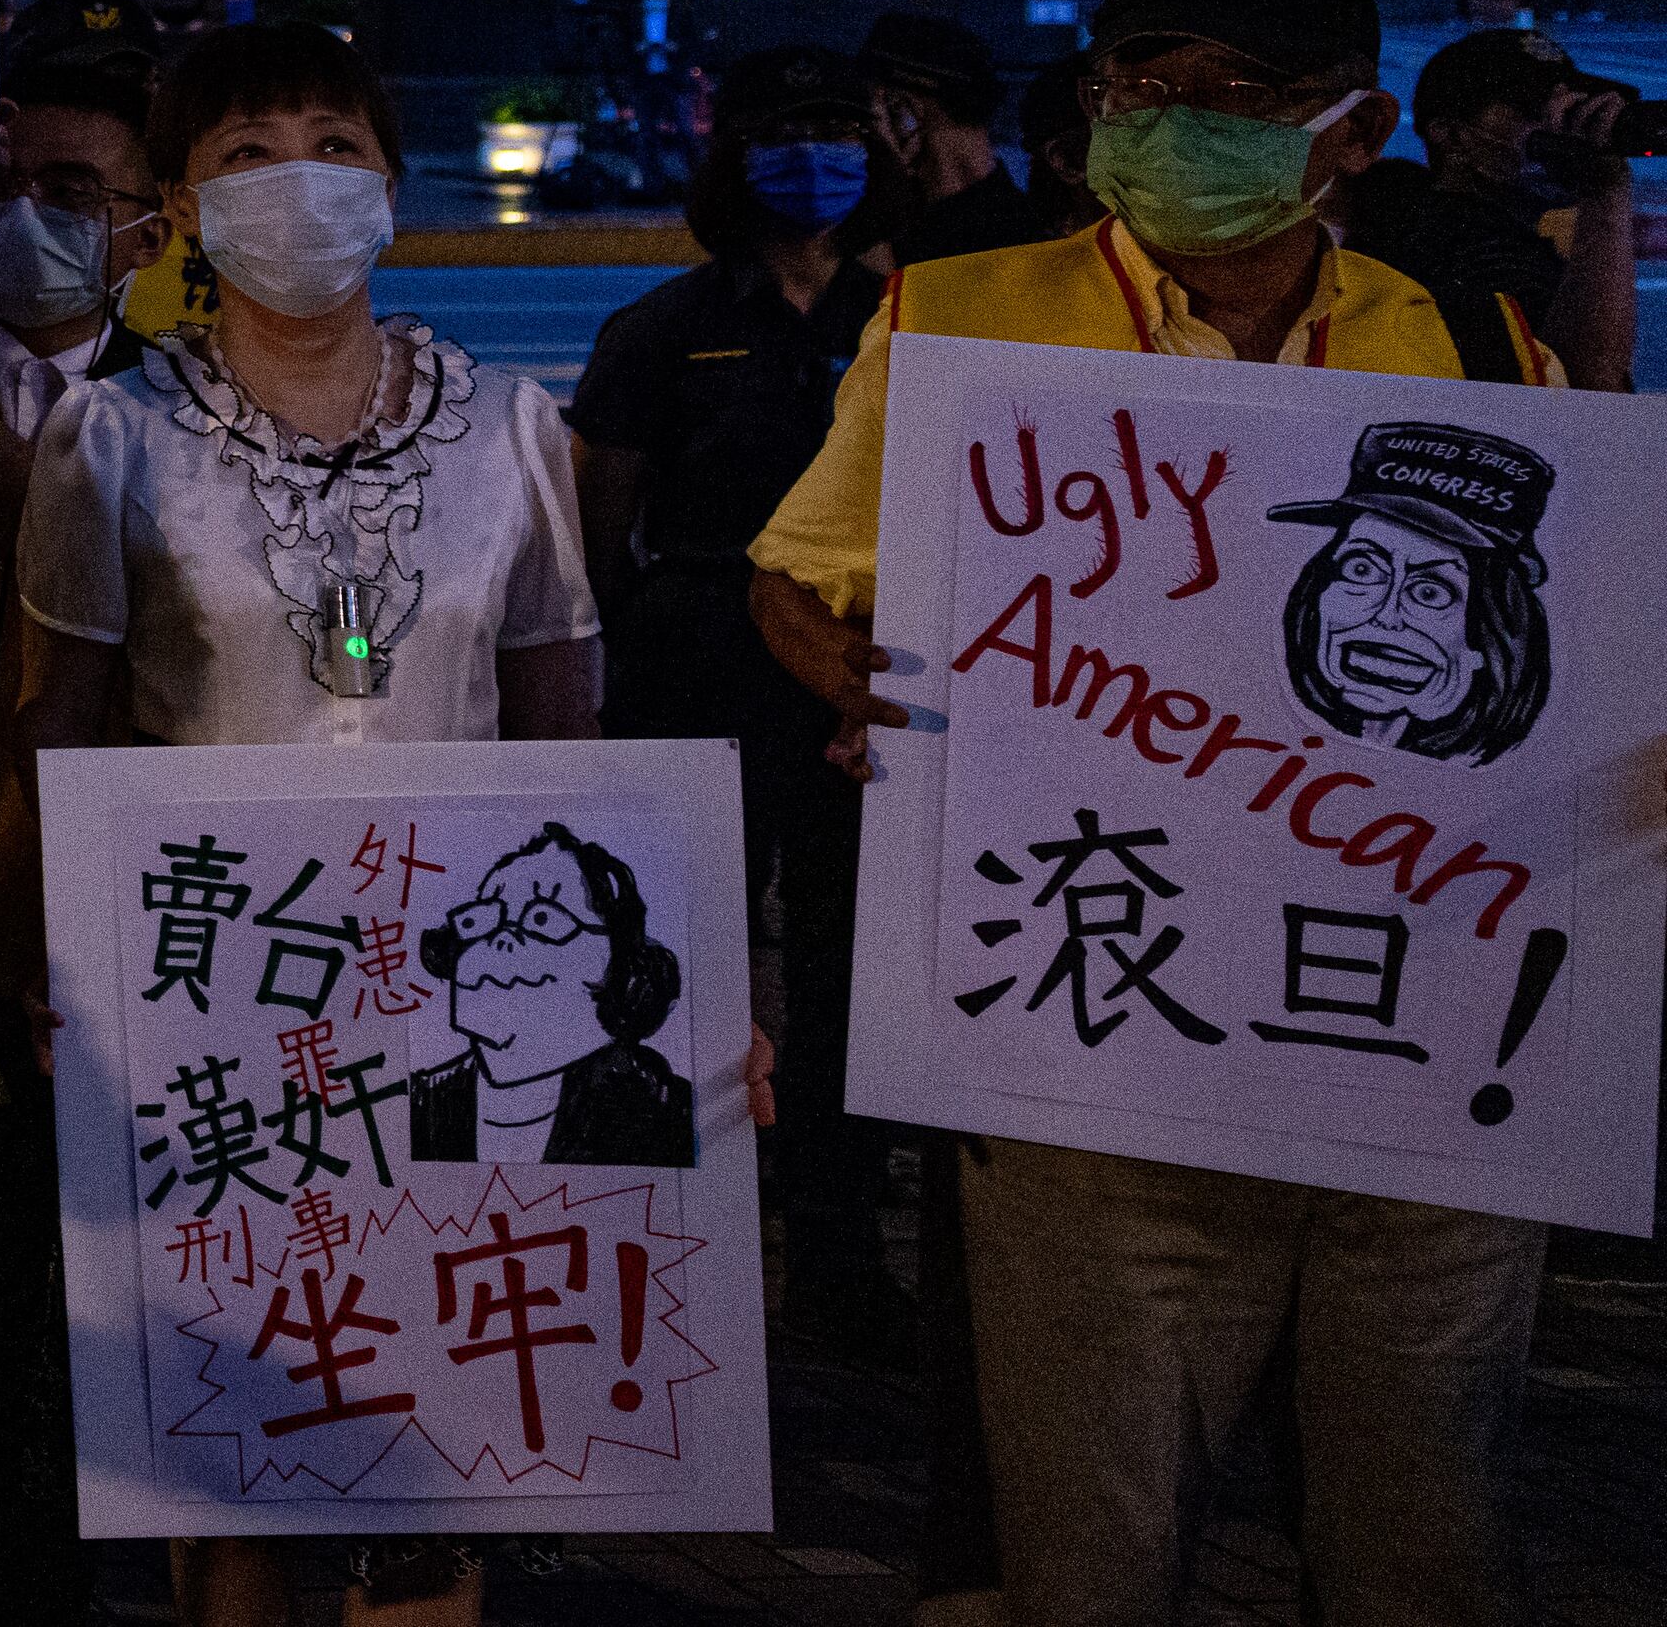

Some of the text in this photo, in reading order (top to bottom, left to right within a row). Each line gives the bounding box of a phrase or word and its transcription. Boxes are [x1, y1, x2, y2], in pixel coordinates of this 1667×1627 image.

[968, 406, 1237, 601] Ugly
[1375, 461, 1515, 513] CONGRESS
[1387, 437, 1533, 482] UNITED STATES
[953, 574, 1534, 941] American
[141, 834, 367, 1020] 賣台
[135, 1052, 409, 1219] 漢奸
[164, 1187, 353, 1285] 刑事
